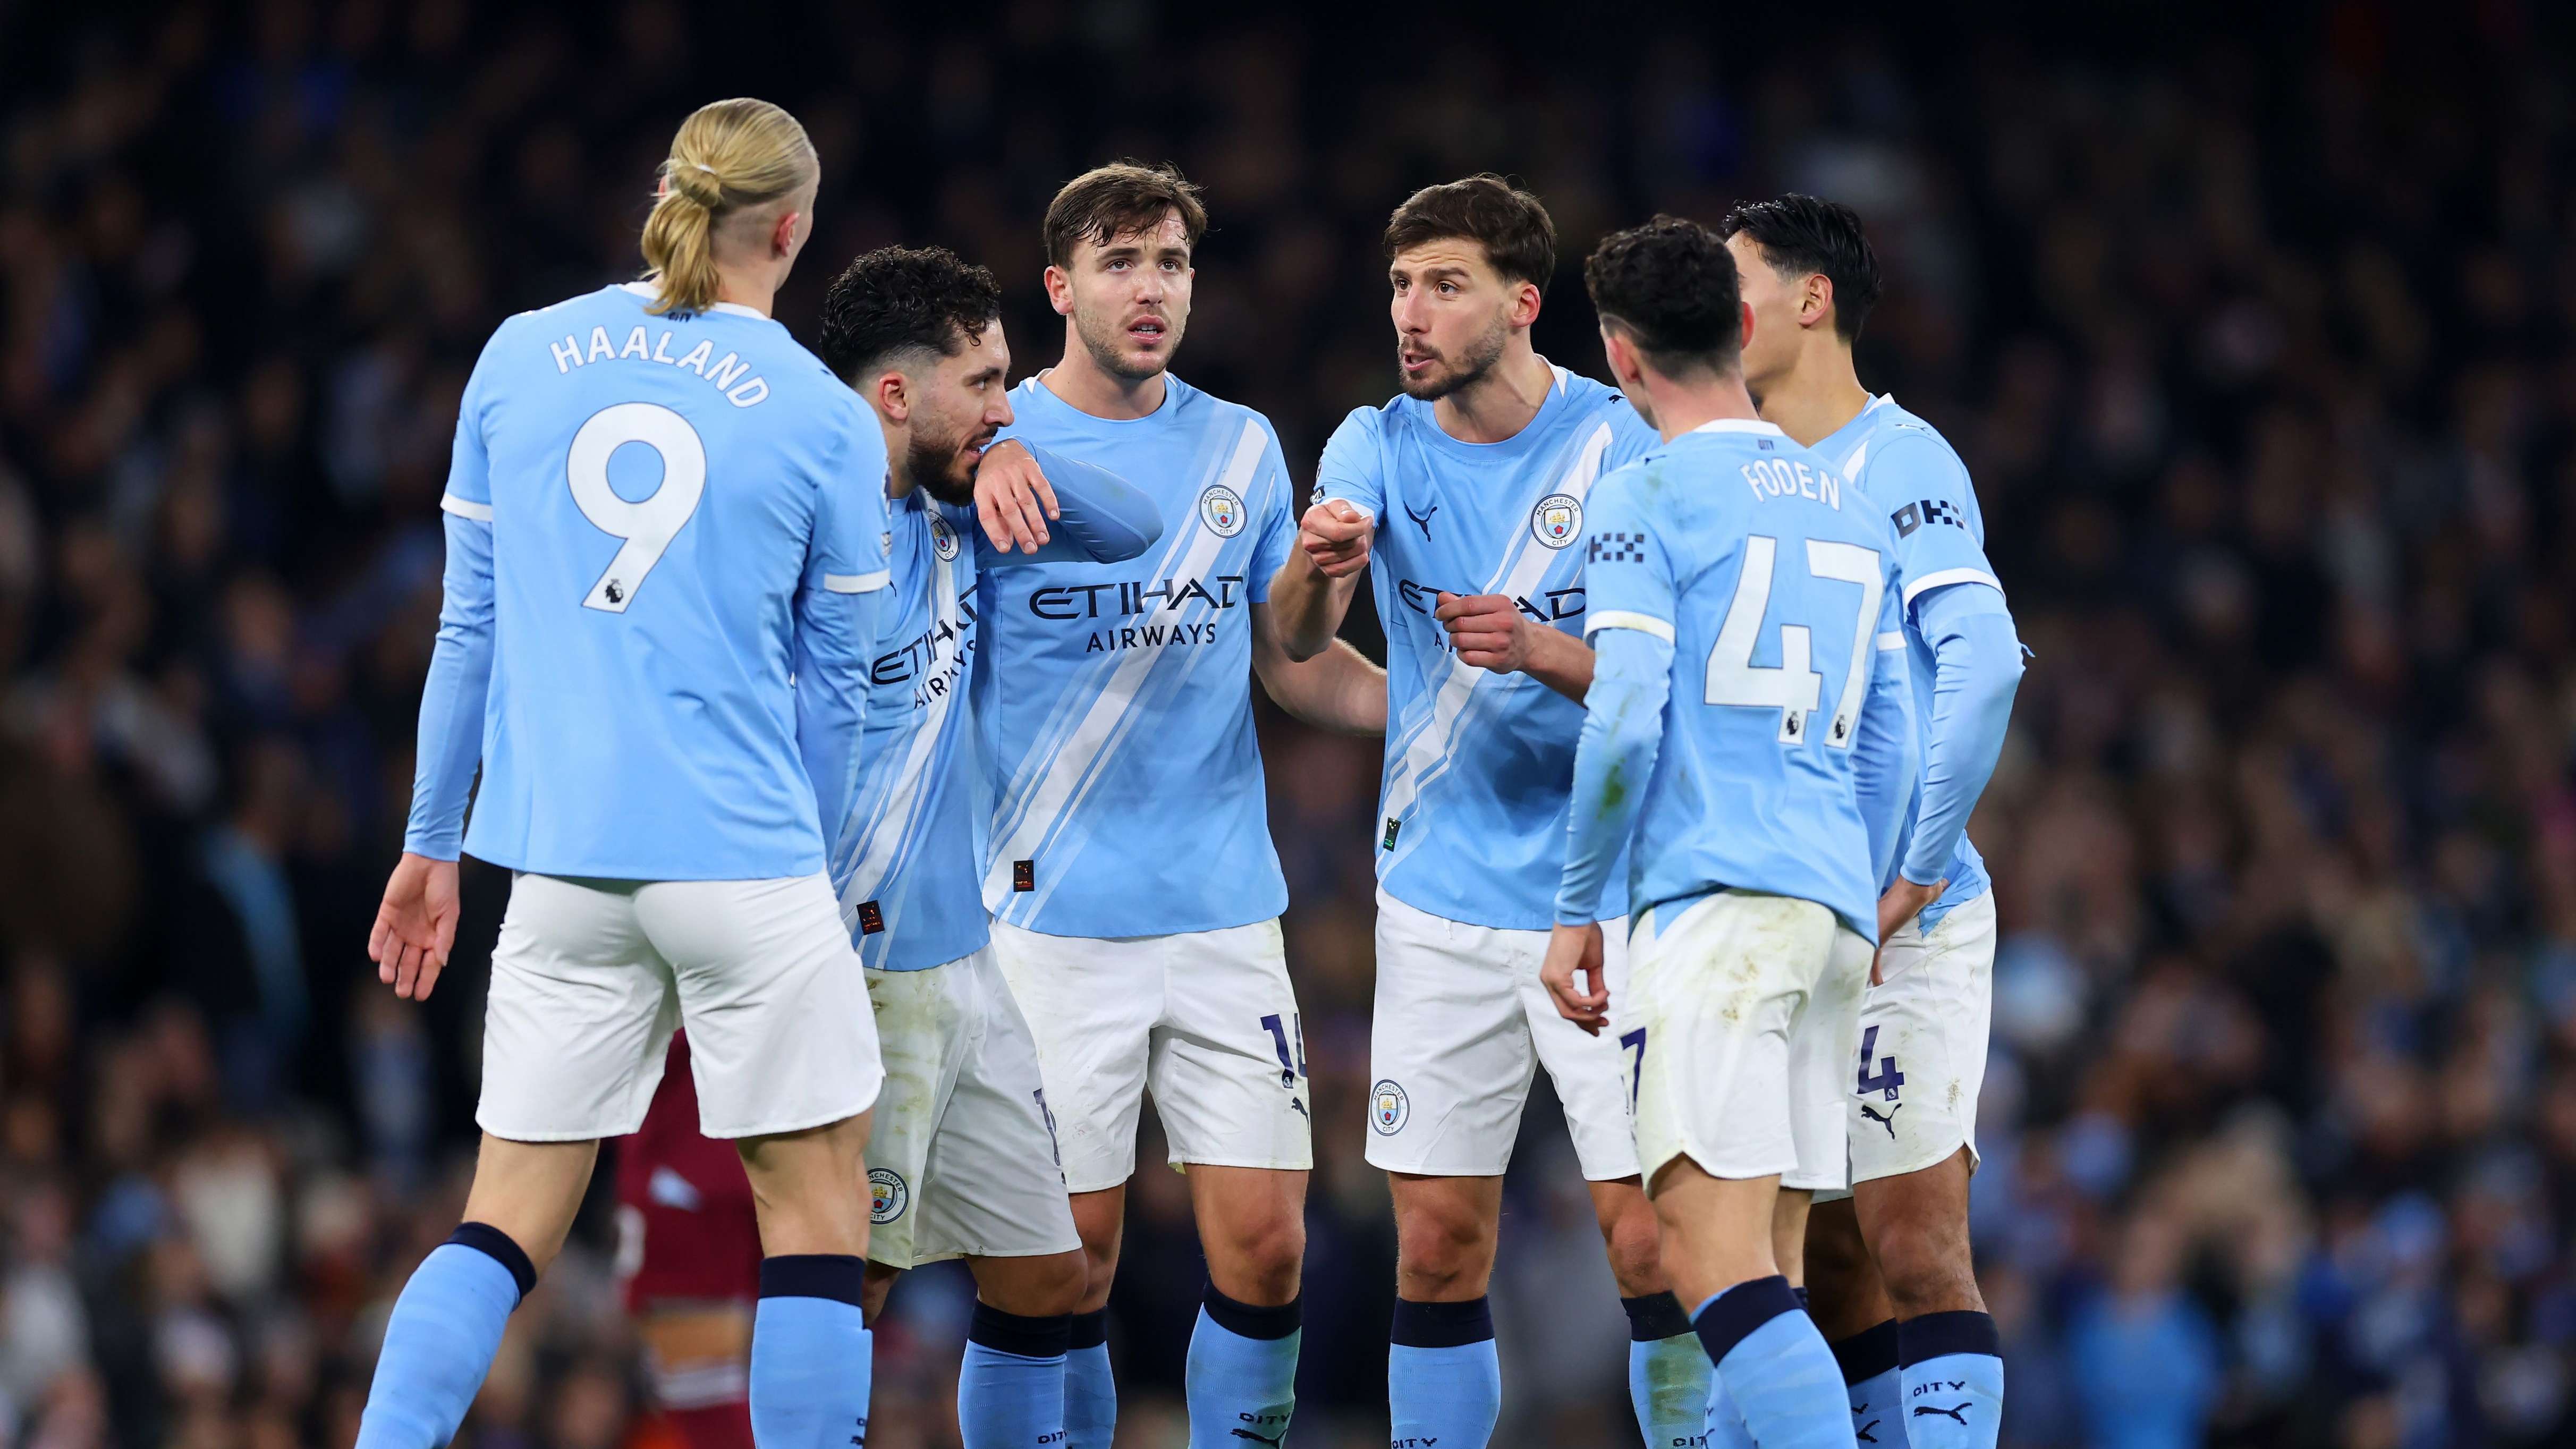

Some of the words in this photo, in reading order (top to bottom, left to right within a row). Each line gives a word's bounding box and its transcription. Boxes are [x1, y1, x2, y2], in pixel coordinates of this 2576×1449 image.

[549, 325, 770, 409] HAALAND
[1203, 489, 1239, 506] MANCHESTER
[1739, 456, 1841, 512] FODEN
[566, 401, 707, 614] 9
[1536, 498, 1579, 516] MANCHESTER
[945, 548, 955, 558] CITY
[1029, 576, 1244, 620] ETIHAD
[1399, 579, 1586, 622] ETAD
[871, 583, 978, 685] ETIH
[1086, 623, 1216, 653] AIRWAYS
[1704, 533, 1885, 749] 47
[1857, 1025, 1904, 1101] 4
[1374, 1084, 1404, 1101] MANCHESTER
[868, 1172, 903, 1192] NCHESTER
[1913, 1381, 1965, 1397] CITY
[1240, 1412, 1291, 1425] CITY
[1392, 1437, 1437, 1449] CITY
